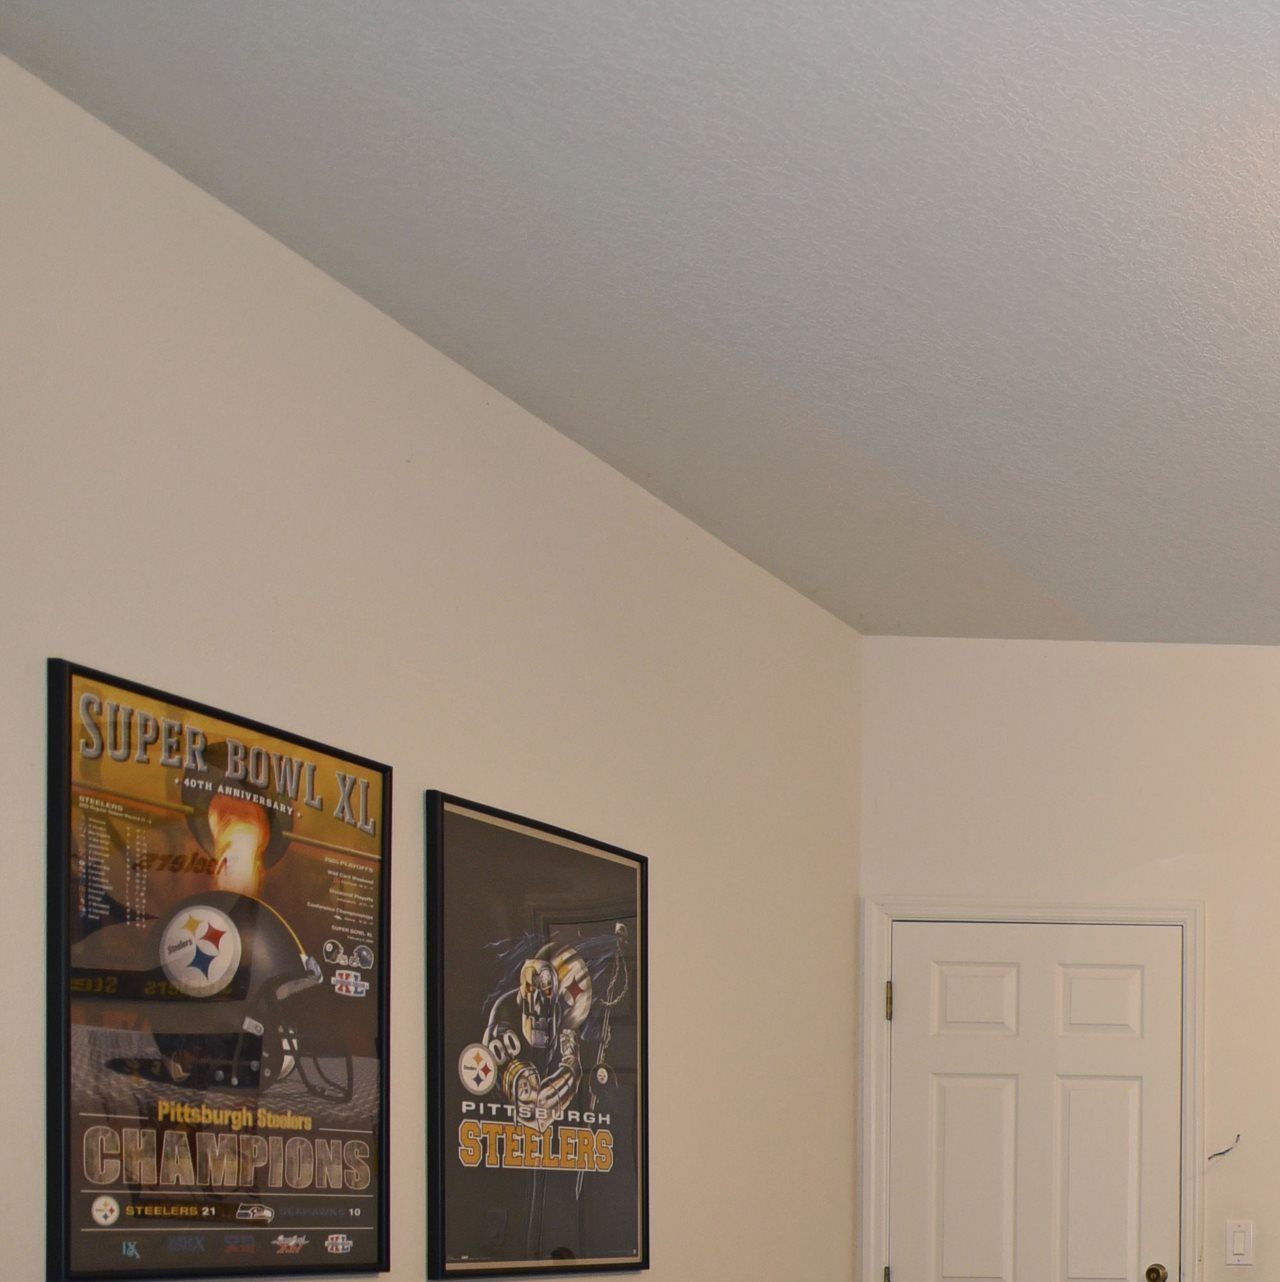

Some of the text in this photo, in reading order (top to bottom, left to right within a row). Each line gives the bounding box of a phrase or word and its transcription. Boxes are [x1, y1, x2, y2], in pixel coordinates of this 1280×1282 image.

[78, 692, 376, 837] SUPER BOWL XL
[183, 776, 295, 816] 40TH ANNIVERSARY
[157, 1099, 312, 1131] Pittsburgh Steelers
[461, 1101, 611, 1125] PITTSBURGH
[83, 1125, 371, 1191] CHAMPIONS
[458, 1118, 614, 1173] STEELERS
[125, 1205, 198, 1217] STEELERS
[202, 1205, 216, 1217] 21
[348, 1207, 361, 1217] 10
